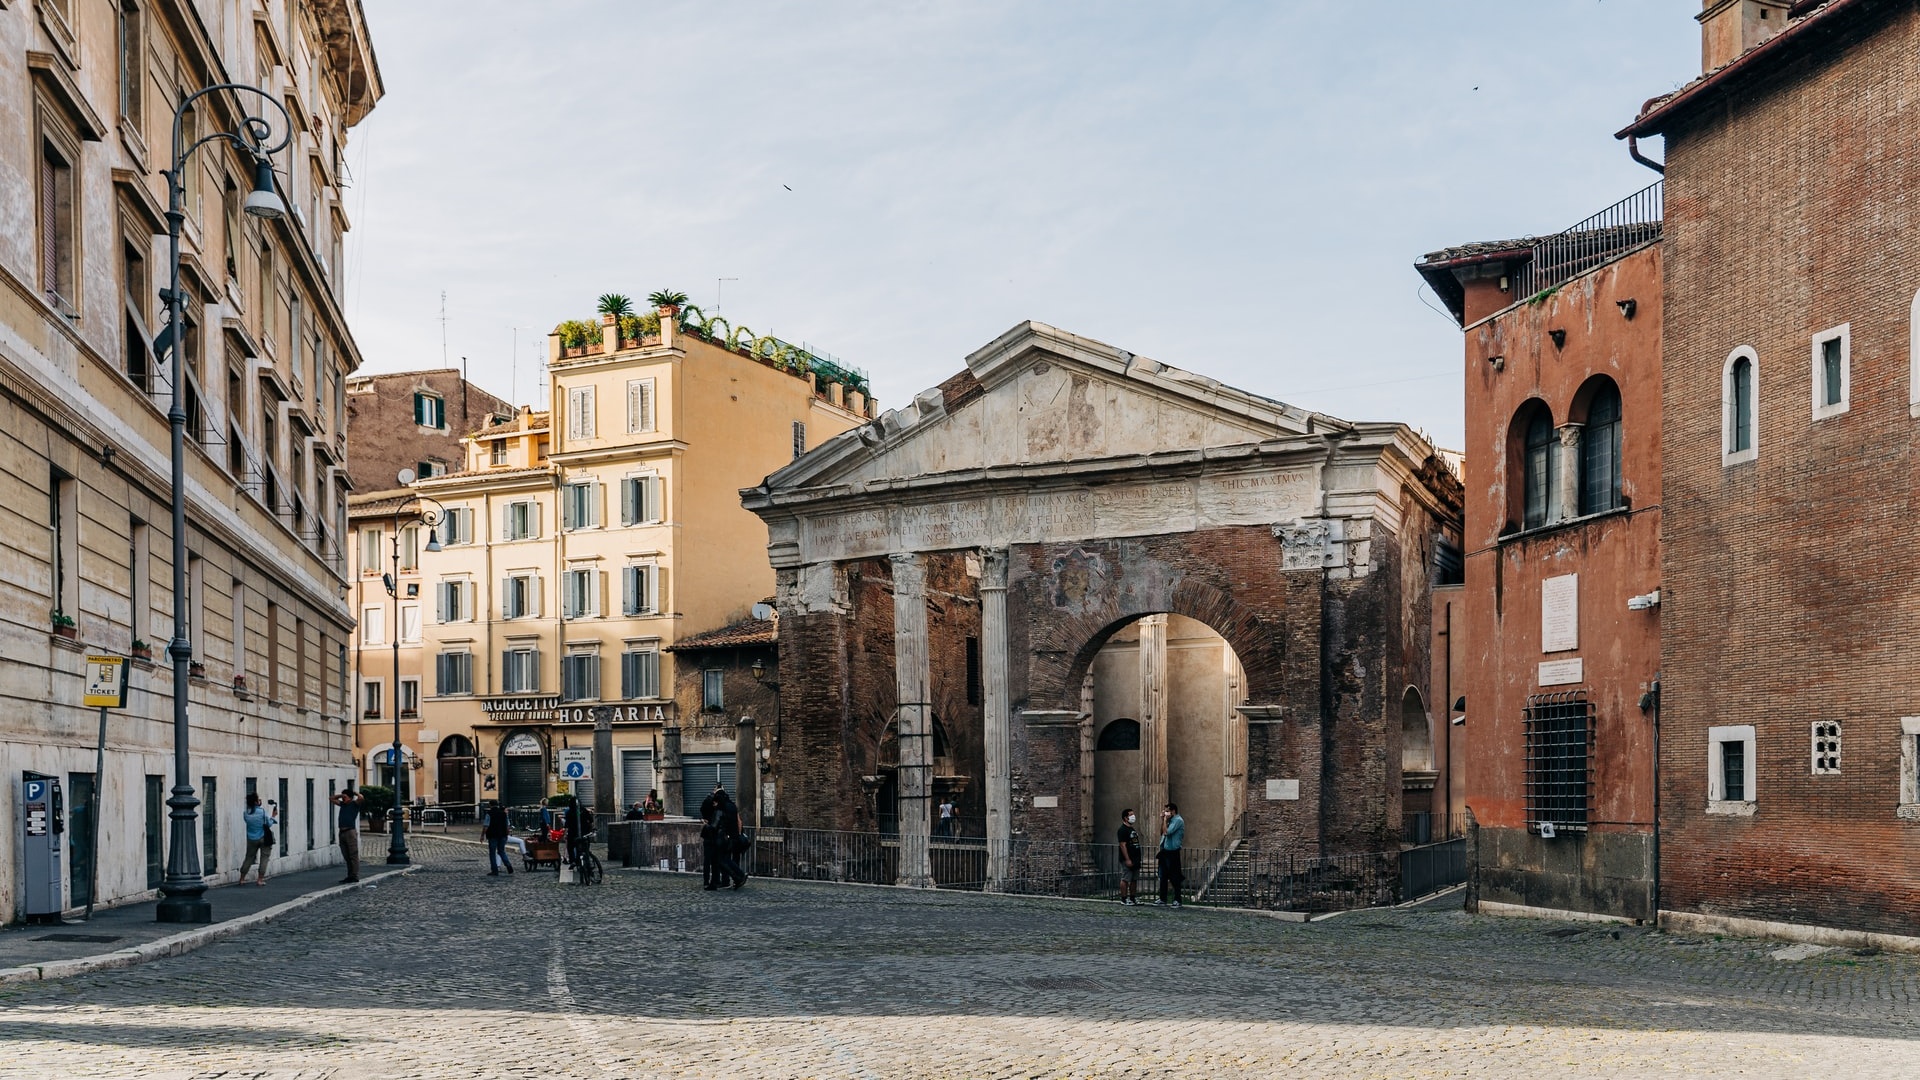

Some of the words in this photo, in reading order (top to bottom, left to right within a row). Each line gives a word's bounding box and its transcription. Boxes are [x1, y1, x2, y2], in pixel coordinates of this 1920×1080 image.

[1250, 472, 1305, 488] MAXIMVS
[481, 700, 494, 712] DA
[493, 697, 559, 711] GIGGETTO
[559, 706, 665, 723] HOSARIA
[29, 783, 40, 798] P
